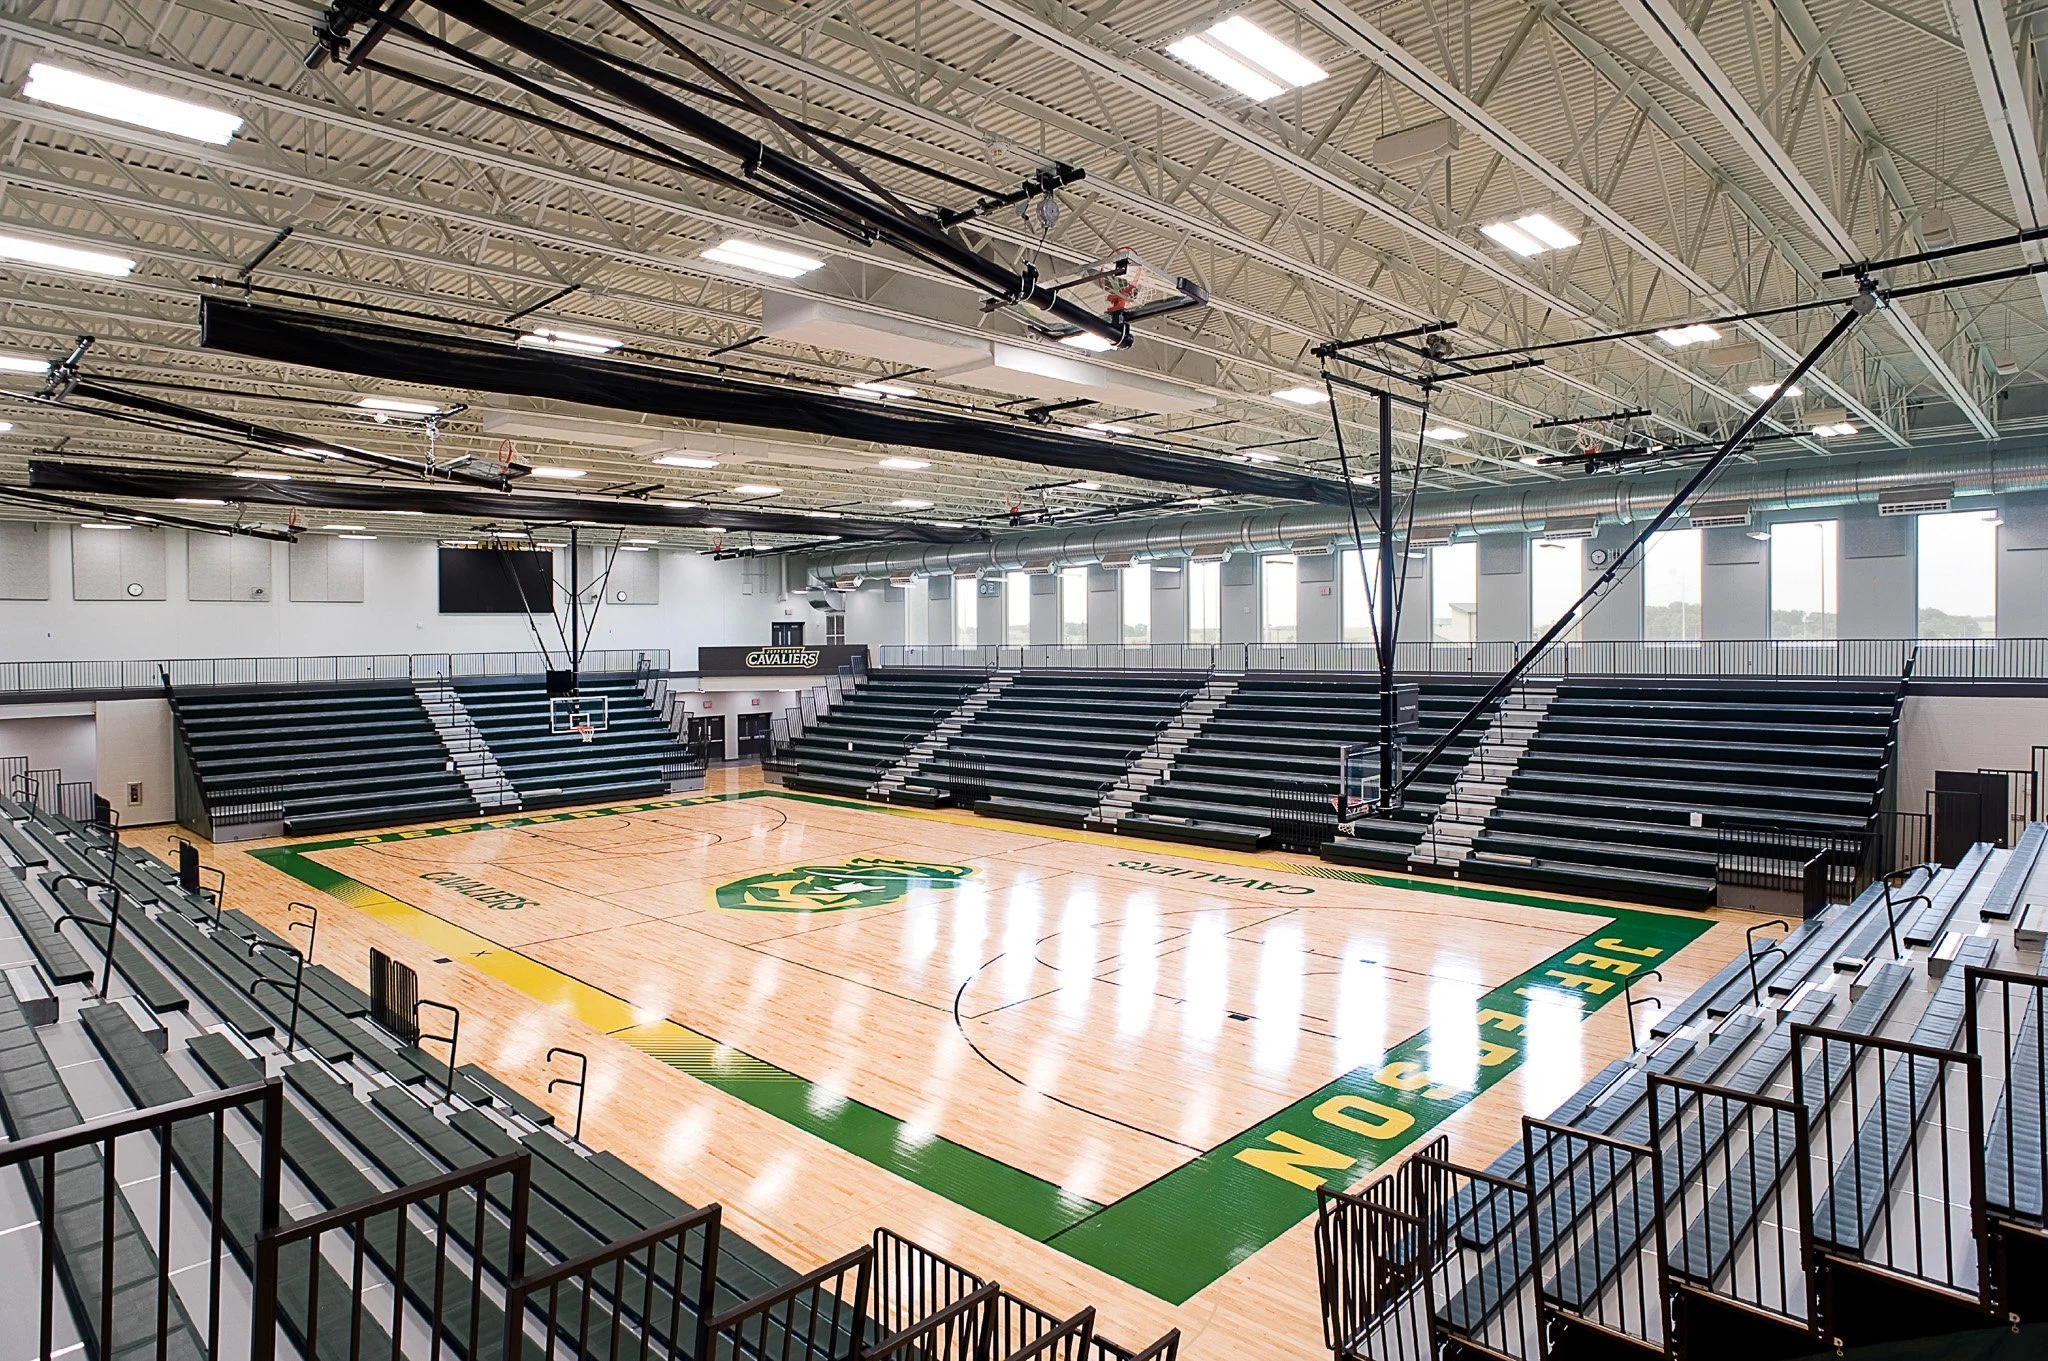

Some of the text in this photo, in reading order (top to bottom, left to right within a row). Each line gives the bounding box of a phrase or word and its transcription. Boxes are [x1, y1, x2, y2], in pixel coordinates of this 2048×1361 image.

[748, 653, 816, 666] CAVALIERS
[353, 796, 722, 845] JEFFERSON
[419, 871, 541, 910] CAVALIERS
[1108, 860, 1315, 895] CAVALIERS
[1233, 938, 1664, 1191] JEFERSON
